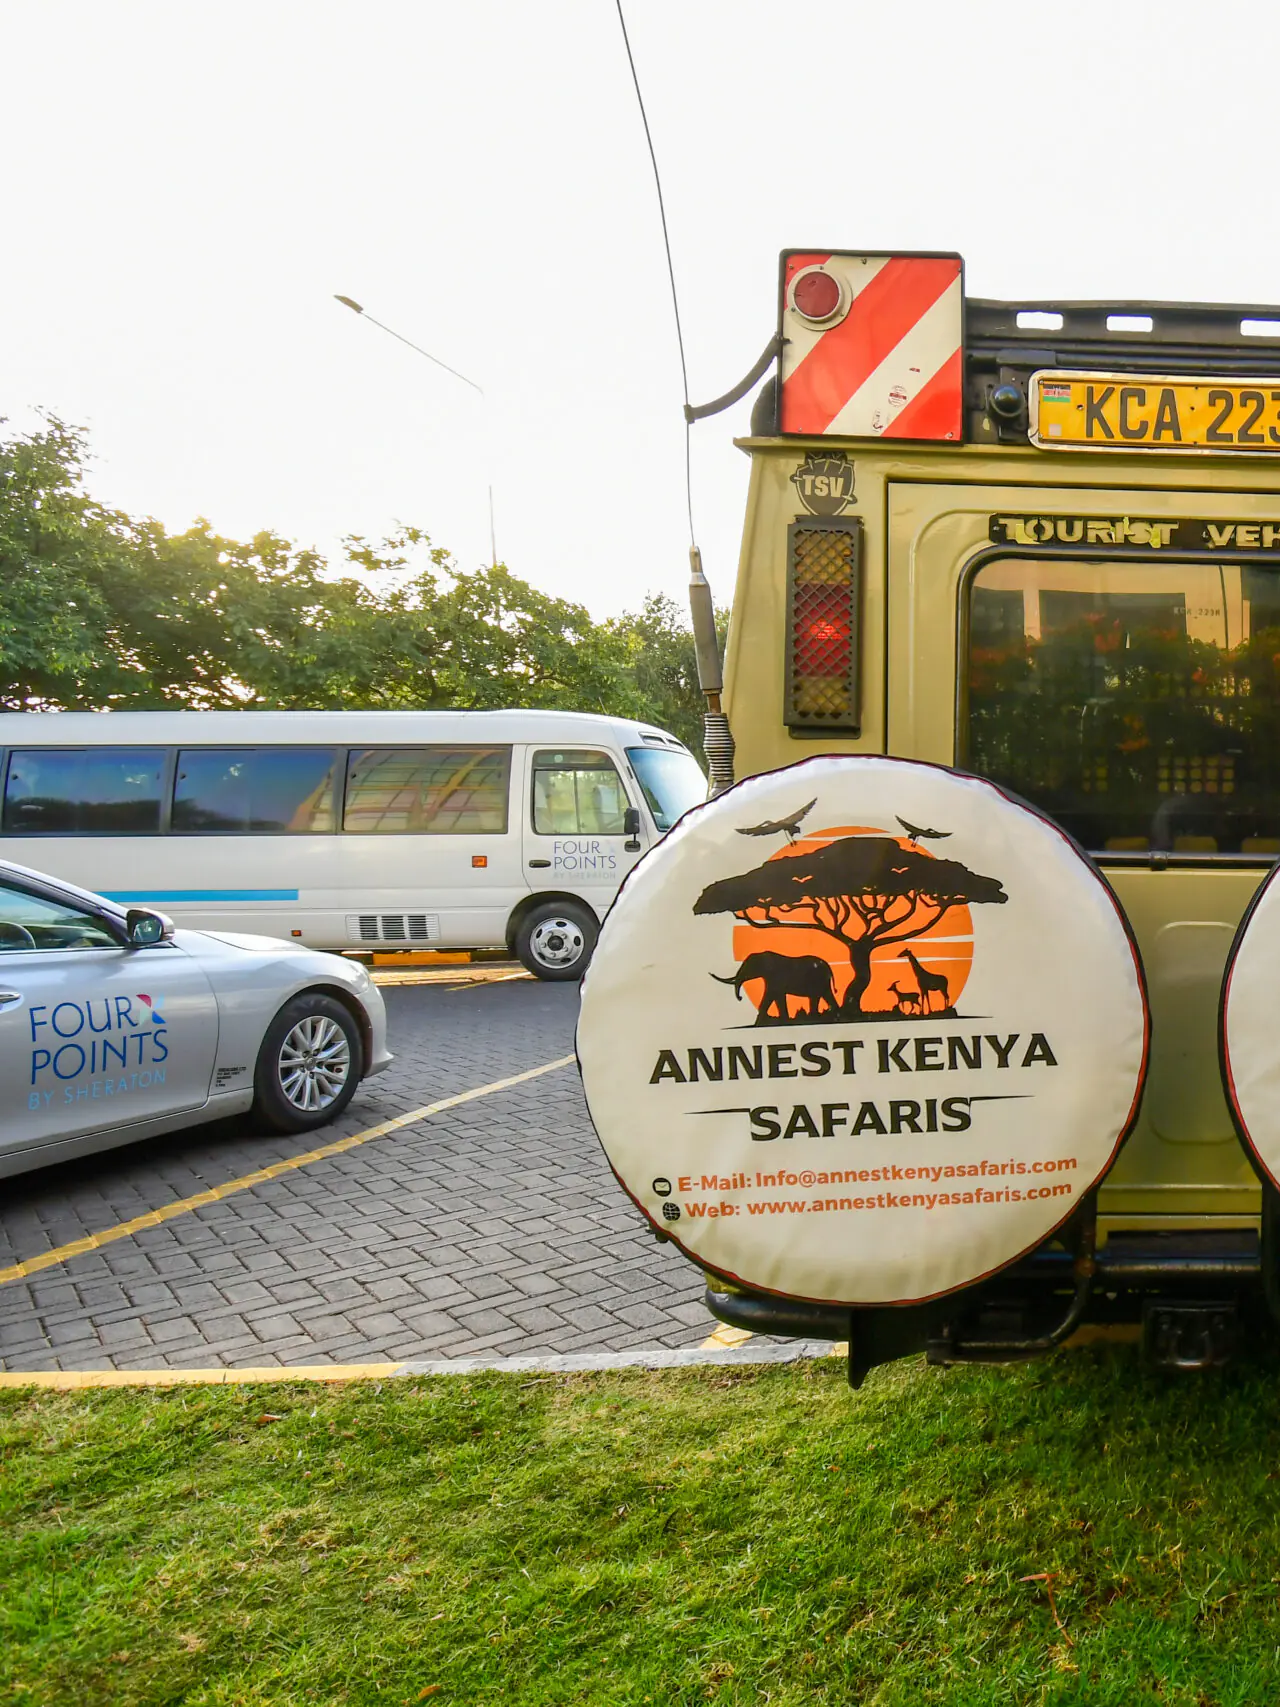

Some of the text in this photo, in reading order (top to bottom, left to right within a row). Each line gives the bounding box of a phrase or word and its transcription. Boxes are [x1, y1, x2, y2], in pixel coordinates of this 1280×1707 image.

[1085, 385, 1183, 441] KCA
[802, 475, 844, 498] TSV
[999, 517, 1179, 548] TOURIST
[554, 840, 601, 854] FOUR
[554, 855, 617, 870] POINTS
[29, 996, 138, 1042] FOUR
[31, 1029, 169, 1085] POINTS
[648, 1032, 1059, 1084] ANNEST KENYA
[28, 1069, 167, 1111] BY SHERATON
[749, 1096, 973, 1141] SAFARIS
[677, 1158, 1078, 1192] E-Mail: Info@annestkenyasafaris.com
[684, 1183, 1072, 1218] Web: www.annestkenyasafaris.com
